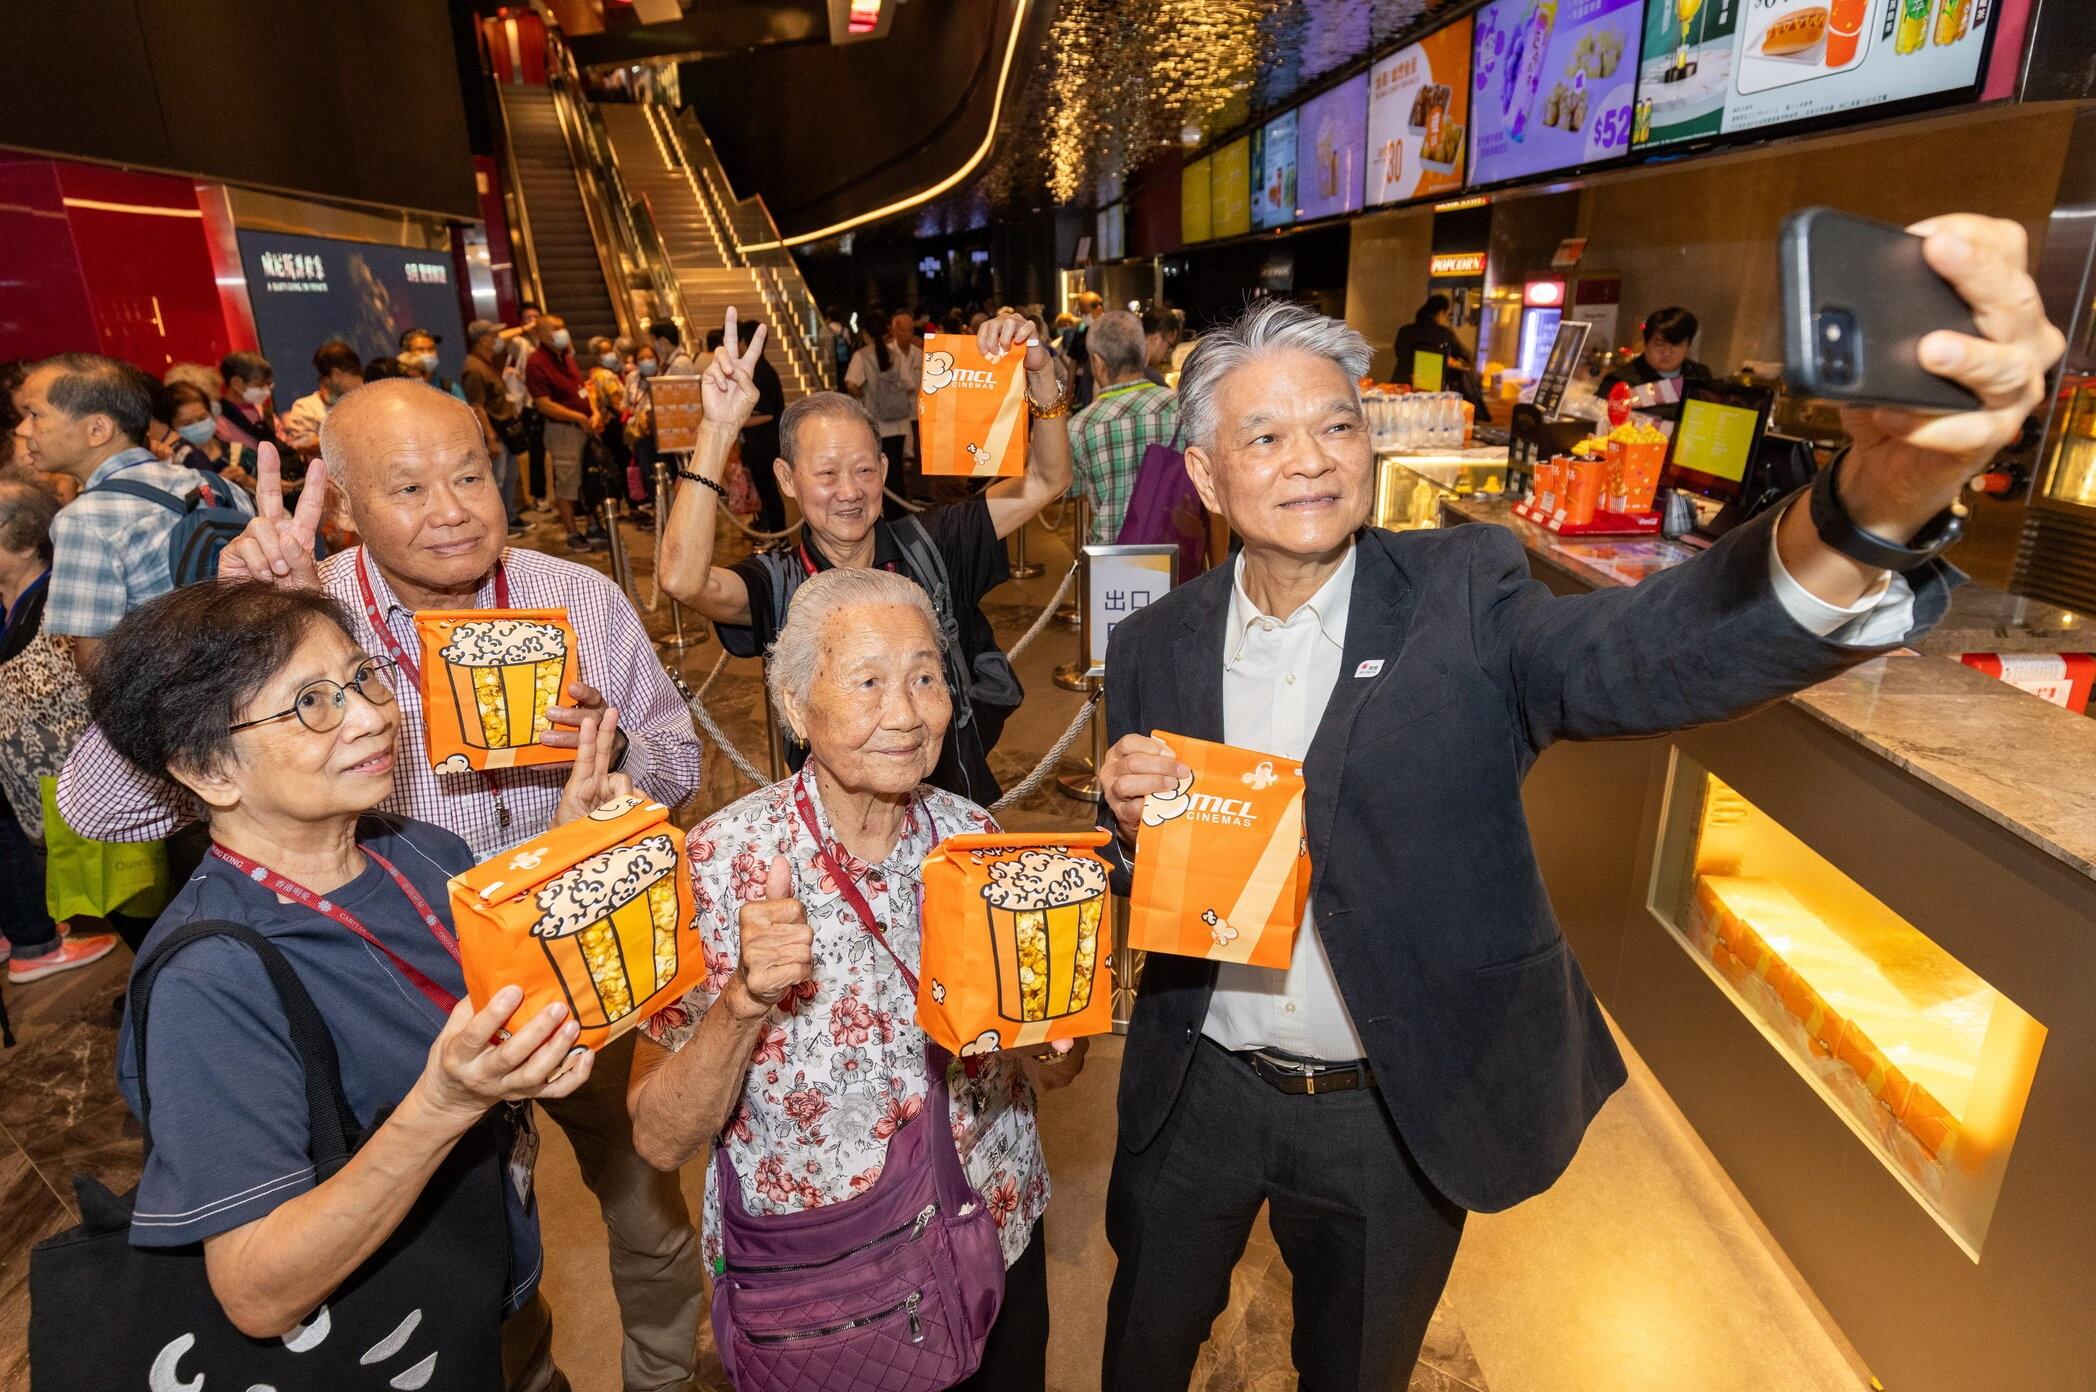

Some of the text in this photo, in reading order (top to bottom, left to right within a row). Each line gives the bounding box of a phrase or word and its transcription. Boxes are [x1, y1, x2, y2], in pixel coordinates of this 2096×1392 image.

[1594, 105, 1632, 148] $52
[1431, 257, 1480, 272] POPCORN
[952, 368, 998, 384] MCL
[952, 381, 995, 390] CINEMAS
[1105, 589, 1150, 611] 出口
[1187, 792, 1258, 820] MCL
[1185, 811, 1253, 828] CINEMAS
[221, 852, 244, 868] KONG
